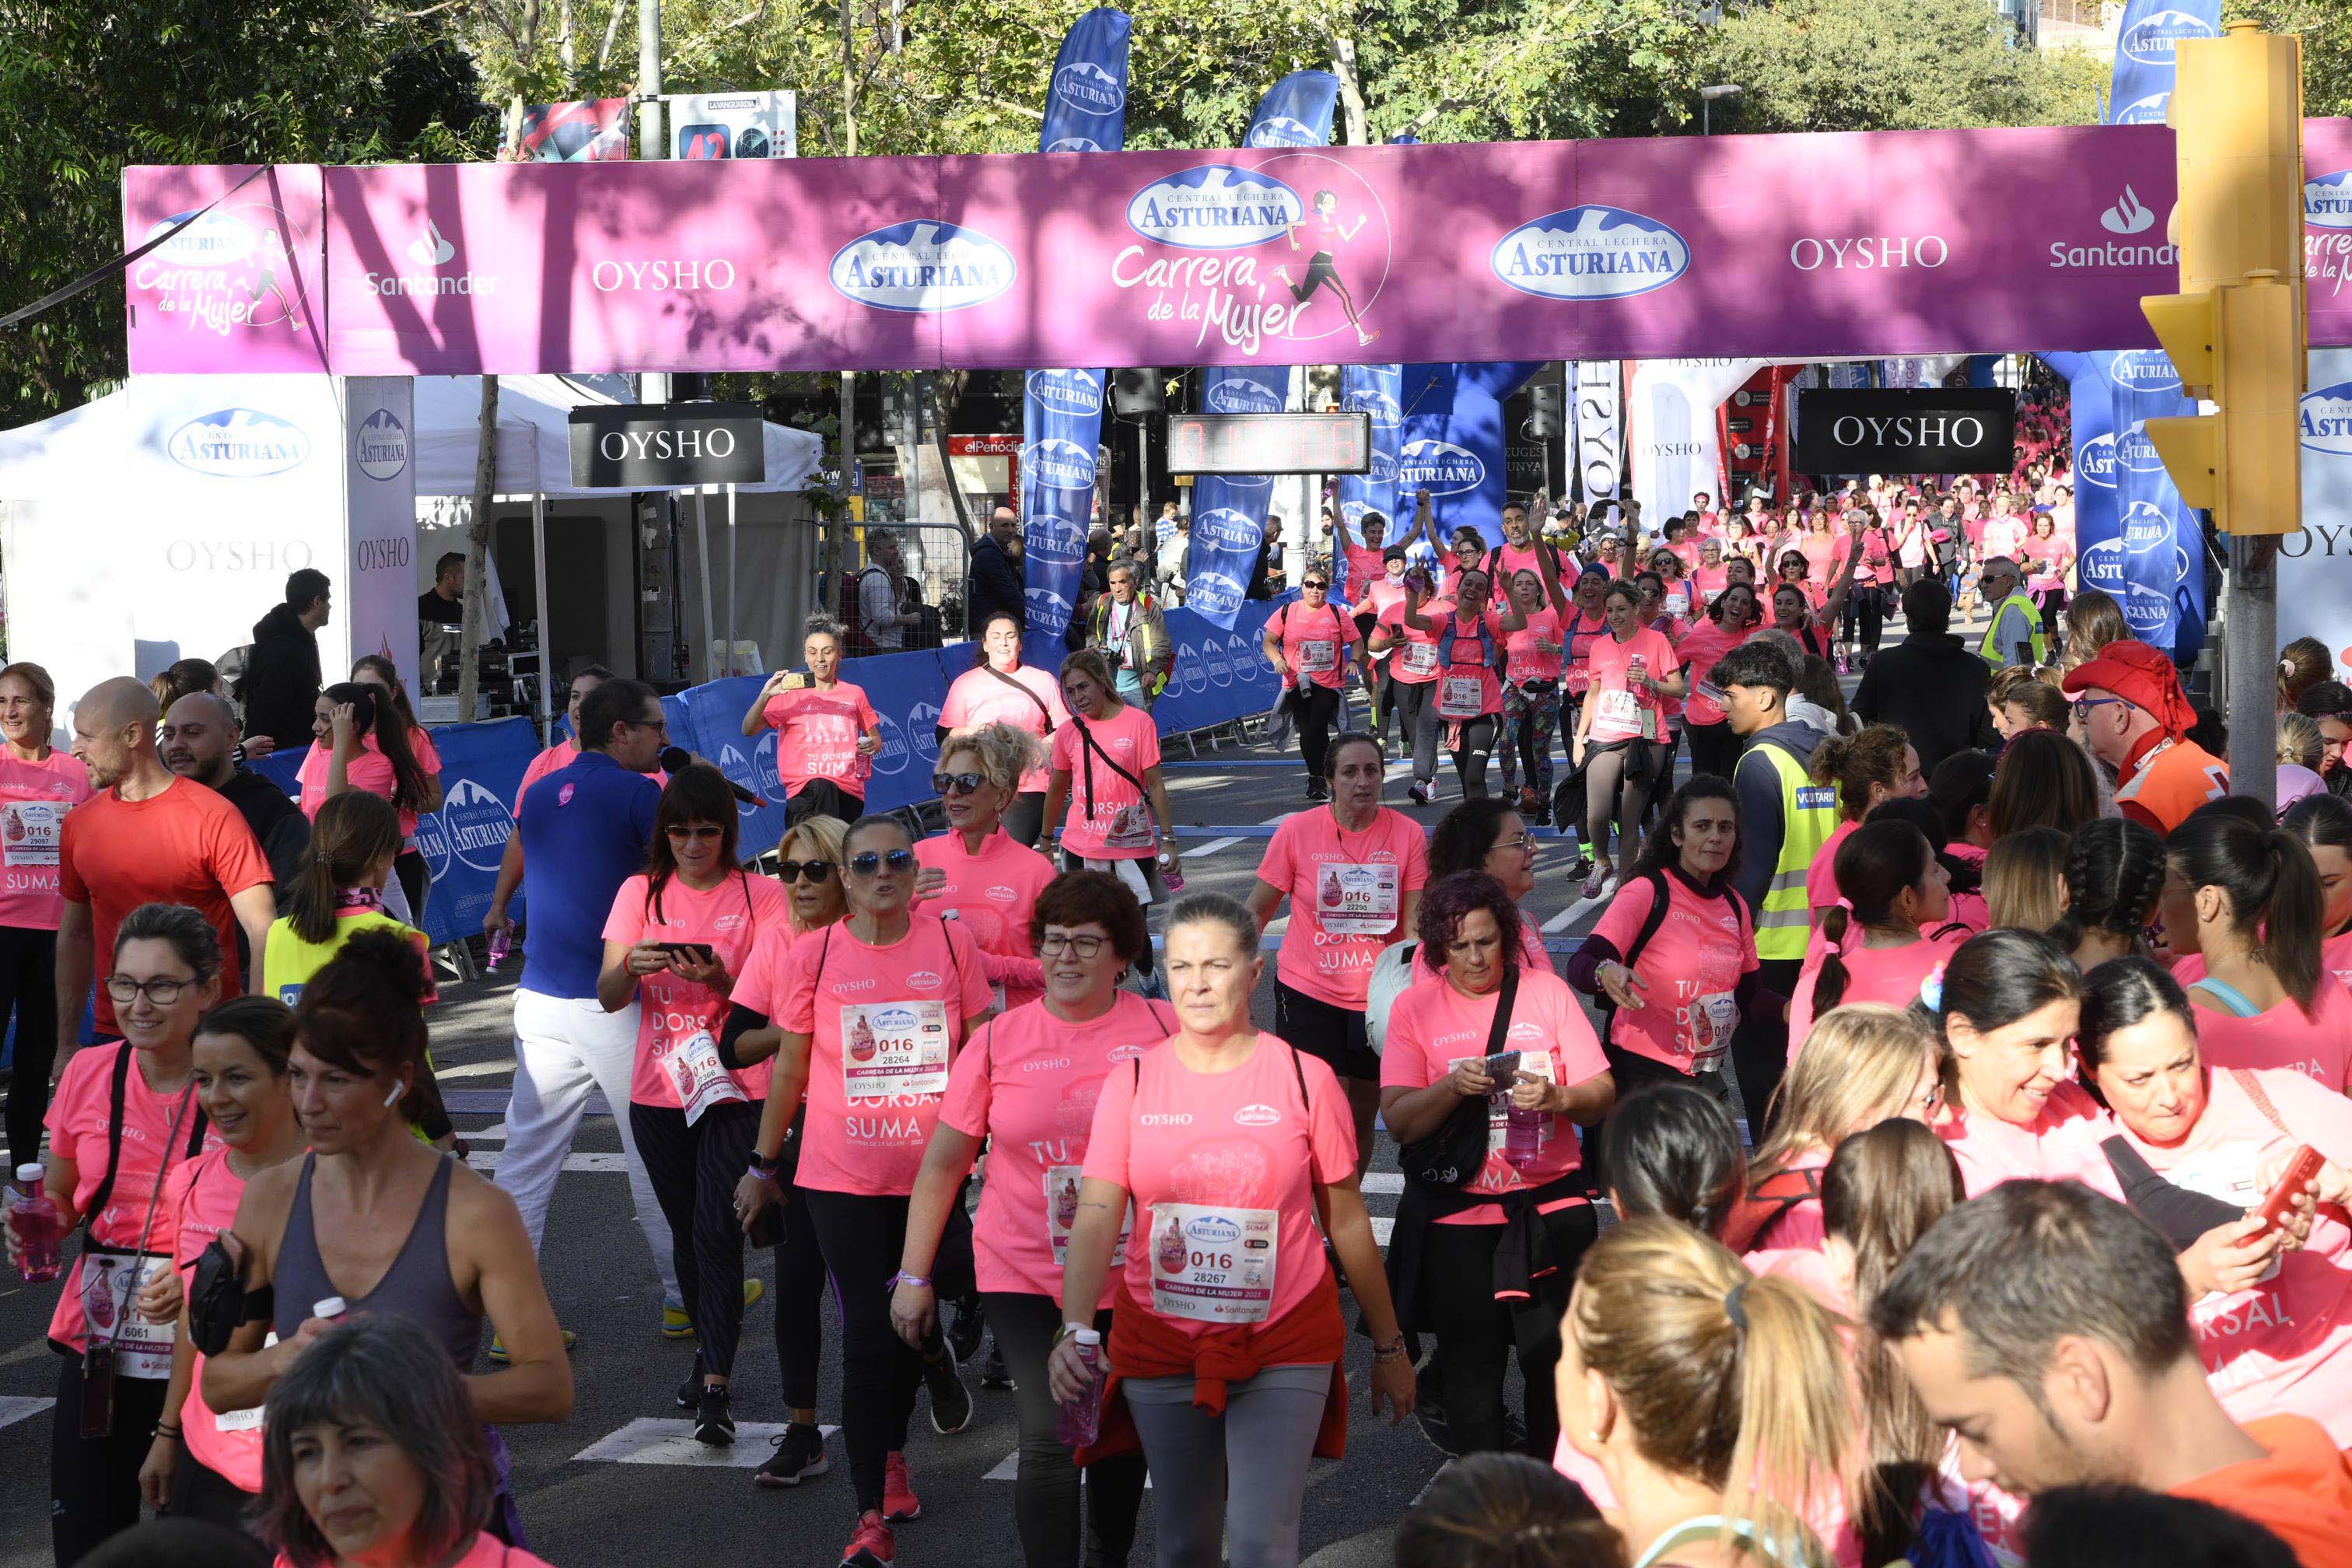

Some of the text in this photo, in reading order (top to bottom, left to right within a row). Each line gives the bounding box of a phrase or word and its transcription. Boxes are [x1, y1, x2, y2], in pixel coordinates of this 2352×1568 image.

[1167, 192, 1285, 203] CENTRAL LECHERA
[1140, 197, 1290, 228] ASTURIANA
[1537, 236, 1668, 249] CENTRAL LECHERA
[1507, 242, 1675, 276] ASTURIANA
[1790, 236, 1948, 270] OYSHO
[845, 254, 1000, 290] ASTURIANA
[1111, 245, 1257, 289] Carrera
[2322, 256, 2336, 278] la
[135, 261, 228, 290] Carrera
[592, 259, 735, 292] OYSHO
[364, 272, 498, 296] Santander
[159, 289, 261, 336] de la Mujer
[1147, 282, 1311, 356] de la Mujer
[1035, 381, 1098, 410] ASTURIANA
[1581, 360, 1615, 499] OYSH
[1832, 416, 1984, 448] OYSHO
[360, 434, 405, 463] ASTURIANA
[600, 428, 736, 462] OYSHO
[1643, 443, 1702, 457] OYSHO
[166, 540, 313, 572] OYSHO
[358, 536, 410, 572] OYSHO
[1511, 656, 1521, 664] TU
[1514, 667, 1547, 676] DORSAL
[1569, 681, 1589, 691] SUM
[1707, 700, 1720, 711] SU
[27, 826, 51, 836] 016
[450, 817, 512, 852] ASTURIANA
[1311, 852, 1344, 862] OYSHO
[6, 873, 60, 890] SUMA
[1343, 876, 1375, 884] ASTURIANA
[1345, 891, 1371, 903] 016
[1325, 921, 1348, 929] OYSHO
[1320, 950, 1374, 969] SUMA
[833, 978, 876, 995] OYSHO
[908, 977, 940, 988] ASTURIANA
[1676, 980, 1700, 999] TU
[650, 985, 672, 1006] TU
[873, 1016, 915, 1027] ASTURIANA
[1714, 1023, 1731, 1038] 016
[879, 1038, 914, 1053] 016
[1433, 1030, 1476, 1048] OYSHO
[693, 1056, 717, 1078] 016
[882, 1055, 910, 1066] 28264
[1023, 1057, 1071, 1073] OYSHO
[904, 1066, 923, 1075] MUJER
[854, 1080, 886, 1090] OYSHO
[910, 1078, 940, 1087] Santander
[1489, 1091, 1510, 1106] 01
[846, 1116, 922, 1139] SUMA
[1141, 1113, 1194, 1126] OYSHO
[1028, 1139, 1066, 1164] TU
[1189, 1225, 1237, 1237] ASTURIANA
[1191, 1251, 1233, 1269] 016
[1194, 1272, 1227, 1284] 28267
[1164, 1284, 1195, 1293] CARRERA
[1217, 1290, 1243, 1298] MUJER
[1163, 1298, 1195, 1311] OYSHO
[1224, 1305, 1262, 1314] Santander
[124, 1326, 149, 1339] 6061
[127, 1342, 135, 1350] DE
